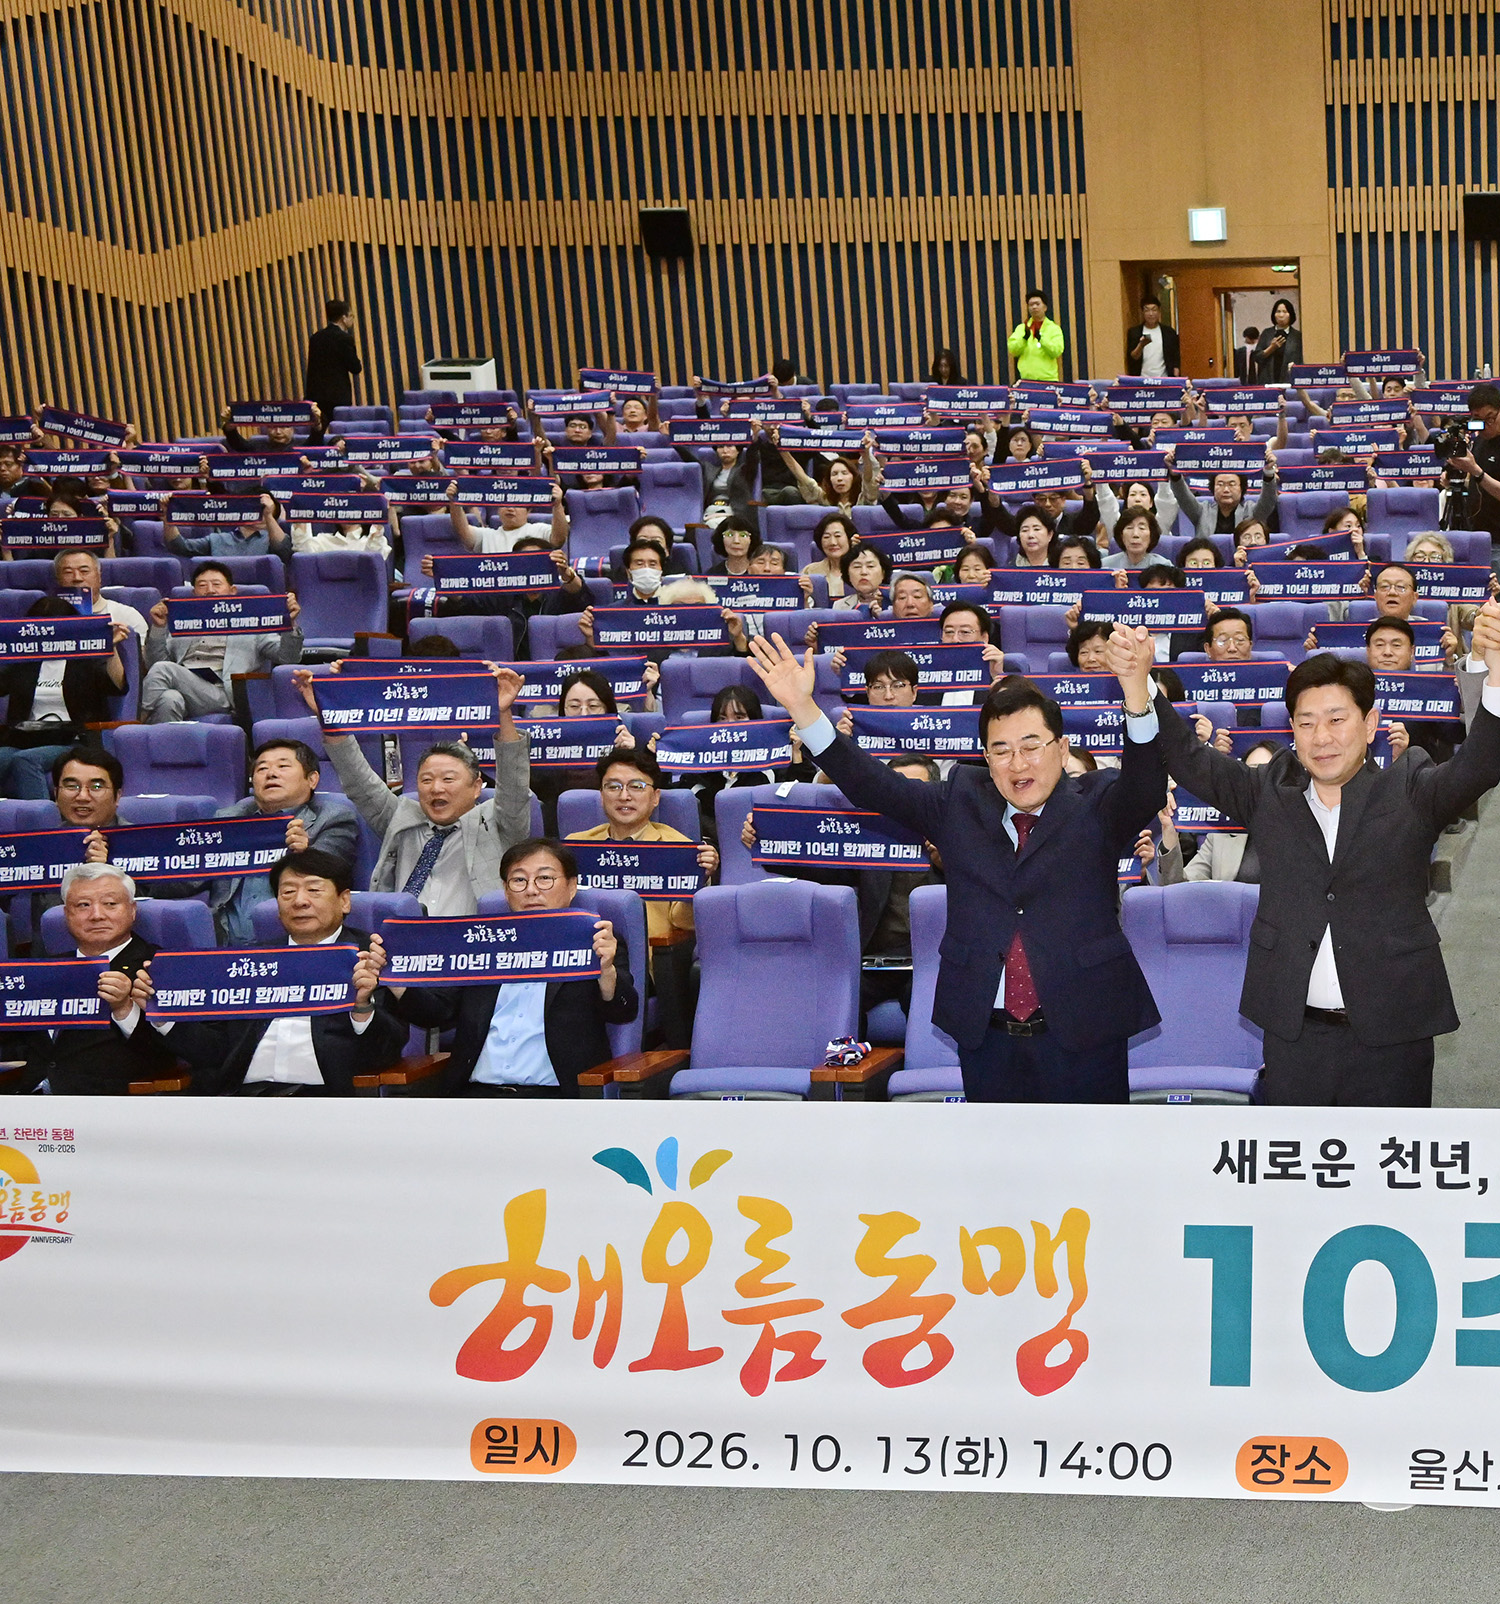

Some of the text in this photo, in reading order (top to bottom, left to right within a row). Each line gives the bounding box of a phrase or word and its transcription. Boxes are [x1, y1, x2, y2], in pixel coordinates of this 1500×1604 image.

[383, 683, 428, 699] 해오름동맹
[322, 706, 491, 724] 함께한 10년! 함께할 미래!
[176, 829, 222, 845] 해오름동맹
[760, 840, 921, 858] 함께한 10년! 함께할 미래!
[112, 857, 159, 873] 함께한
[164, 854, 200, 869] 10년!
[205, 851, 250, 868] 함께할
[623, 875, 664, 891] 함께할
[668, 876, 699, 890] 미래!
[463, 925, 517, 943] 해오름동맹
[227, 958, 277, 977] 해오름동맹
[391, 949, 592, 972] 함께한 10년! 함께할 미래!
[156, 984, 348, 1006] 함께한 10년! 함께할 미래!
[5, 998, 100, 1017] 함께할 미래!
[38, 1144, 76, 1153] 2016-2026
[1213, 1139, 1355, 1188] 새로운
[1379, 1137, 1488, 1195] 천년,
[30, 1236, 73, 1244] ANNIVERSARY
[429, 1182, 1090, 1397] 해오름동맹
[485, 1425, 559, 1466] 일시
[623, 1430, 1171, 1480] 2026. 10. 13(화) 14:00
[1251, 1445, 1331, 1485] 장소
